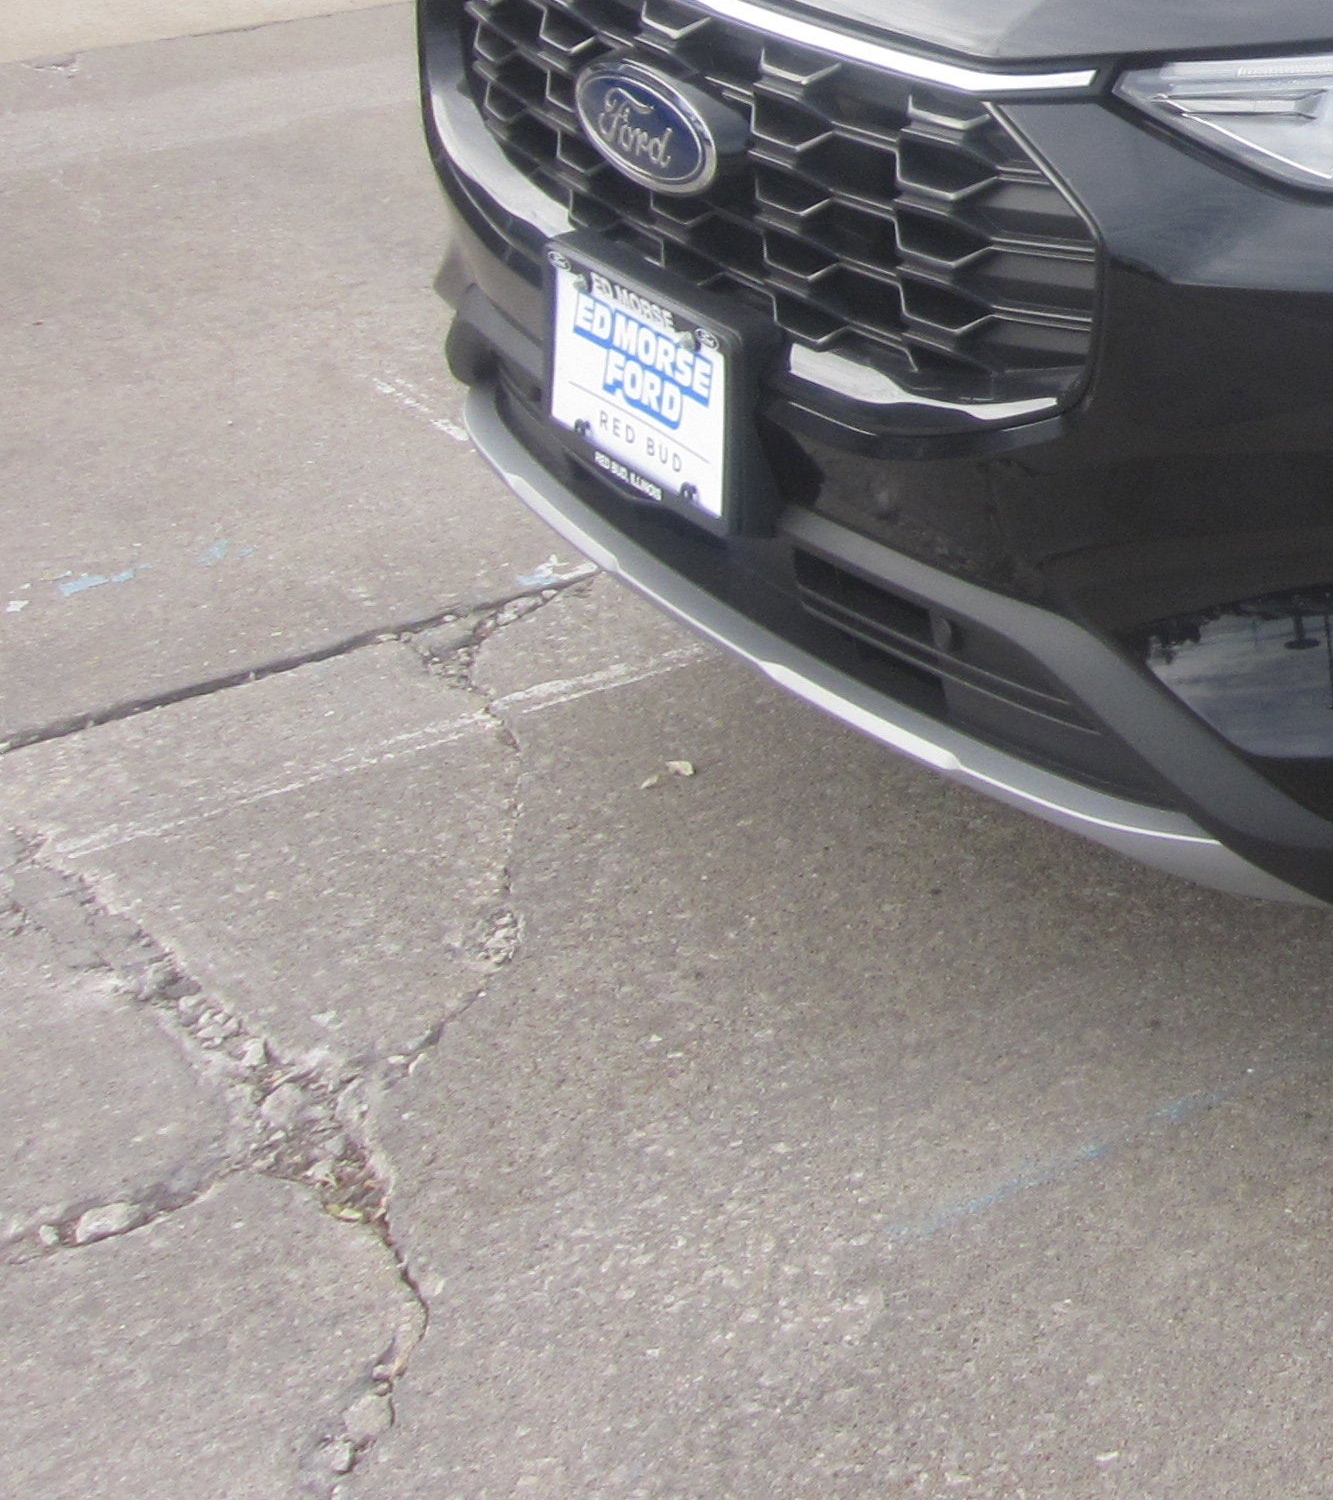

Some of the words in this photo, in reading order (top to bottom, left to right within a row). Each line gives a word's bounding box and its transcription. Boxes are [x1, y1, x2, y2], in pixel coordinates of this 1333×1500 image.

[600, 87, 674, 169] Ford
[590, 271, 614, 301] ED
[614, 284, 675, 329] MORSE
[573, 293, 613, 345] ED
[612, 309, 713, 405] MORSE
[603, 350, 684, 429] FORD
[599, 409, 636, 445] RED
[646, 437, 683, 473] BUD
